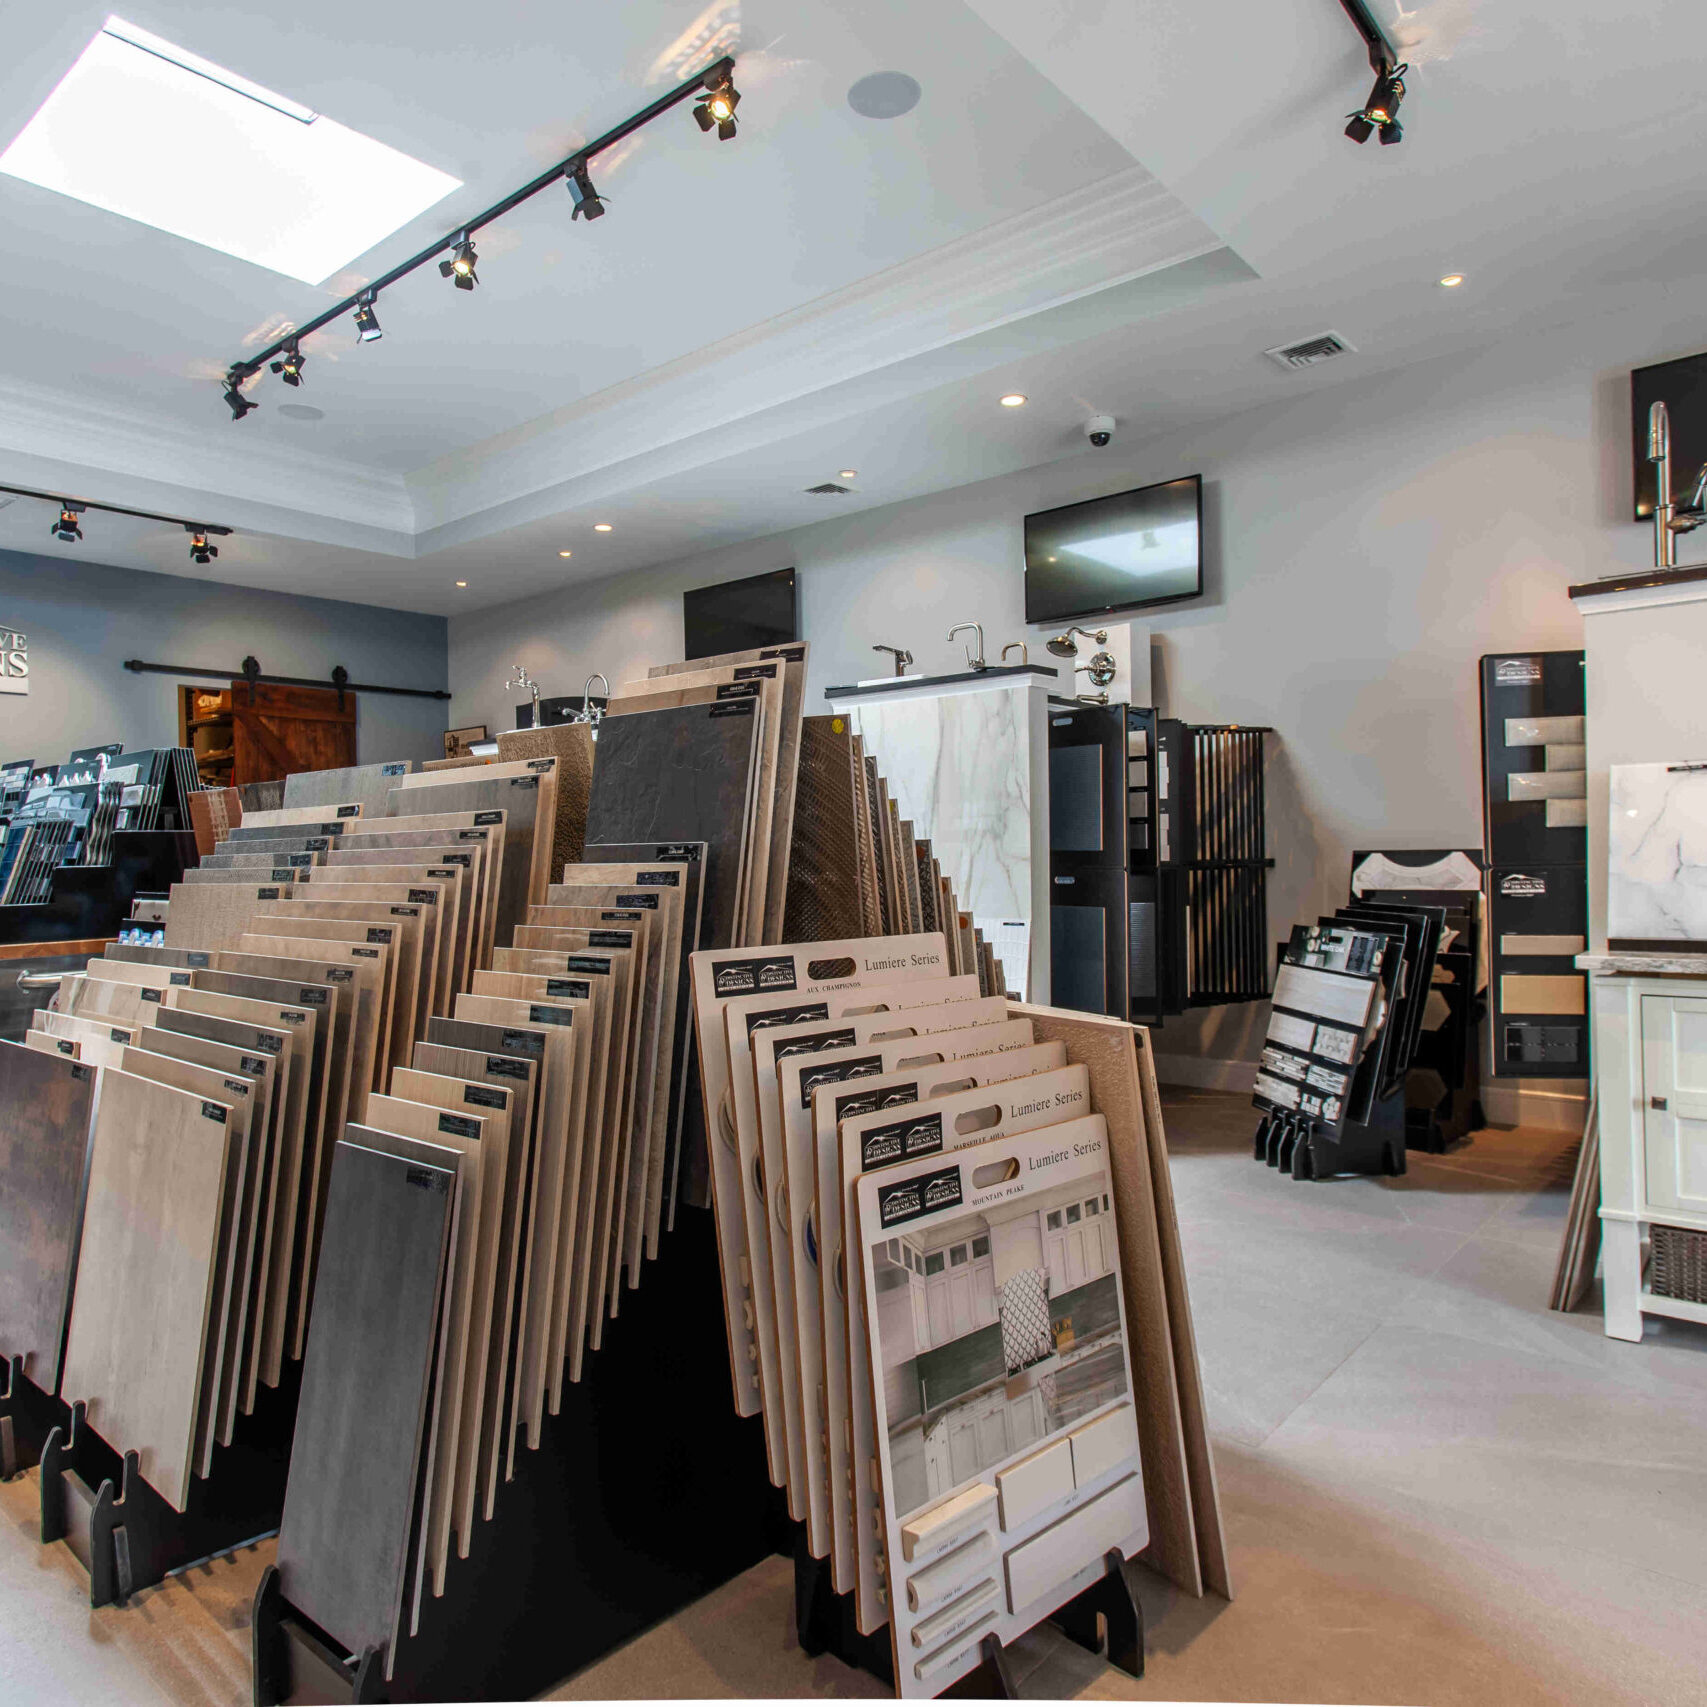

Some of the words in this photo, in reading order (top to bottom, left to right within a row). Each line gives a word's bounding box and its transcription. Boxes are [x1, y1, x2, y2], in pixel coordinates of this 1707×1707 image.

[865, 957, 906, 972] Lumiere
[910, 953, 940, 968] Series
[807, 986, 820, 994] AUX
[822, 981, 861, 992] CHAMPIGNON
[1011, 1098, 1050, 1118] Lumiere
[1054, 1089, 1083, 1106] Series
[1029, 1150, 1069, 1171] Lumiere
[1073, 1139, 1101, 1157] Series
[972, 1192, 1004, 1206] MOUNTAIN
